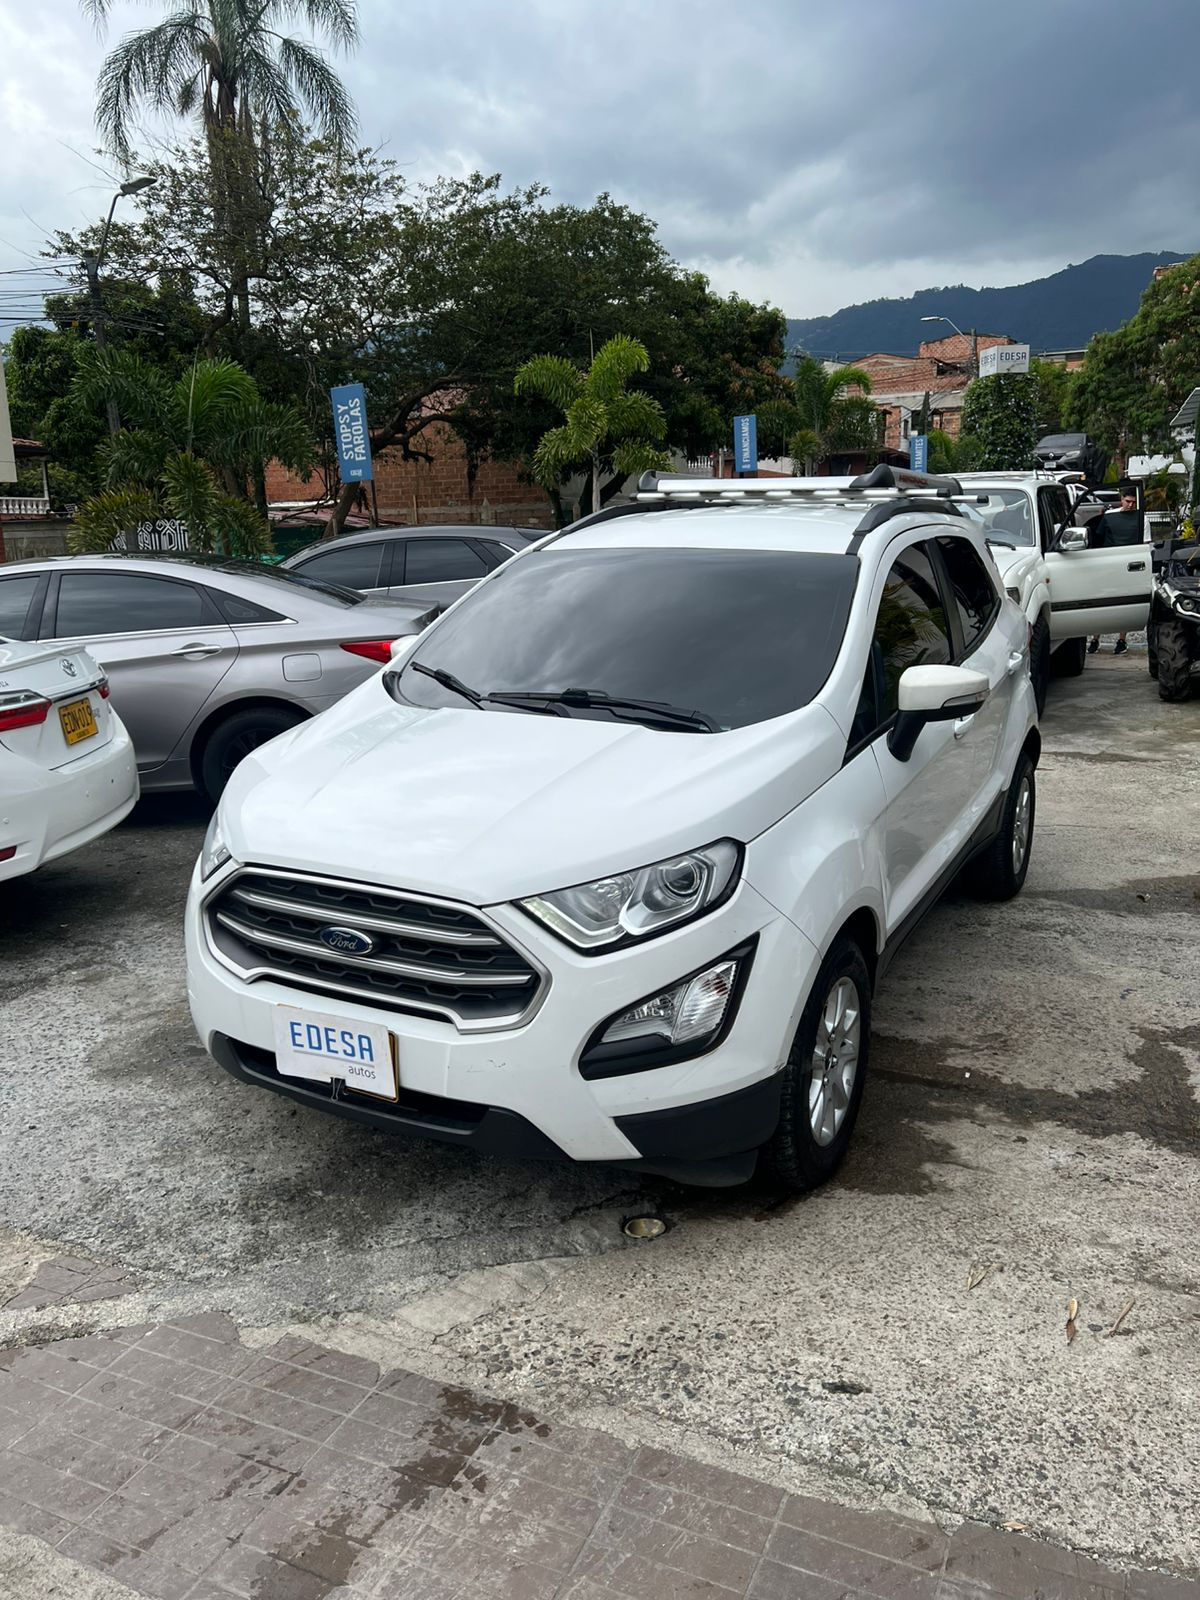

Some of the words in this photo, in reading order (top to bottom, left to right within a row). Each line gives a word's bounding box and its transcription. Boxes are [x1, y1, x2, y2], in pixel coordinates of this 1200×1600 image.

[1000, 351, 1027, 361] EDESA
[348, 398, 366, 461] FAROLAS
[741, 417, 750, 463] FINANCIAMOS
[329, 931, 358, 950] Ford
[289, 1021, 375, 1062] EDESA
[348, 1064, 377, 1079] autos
